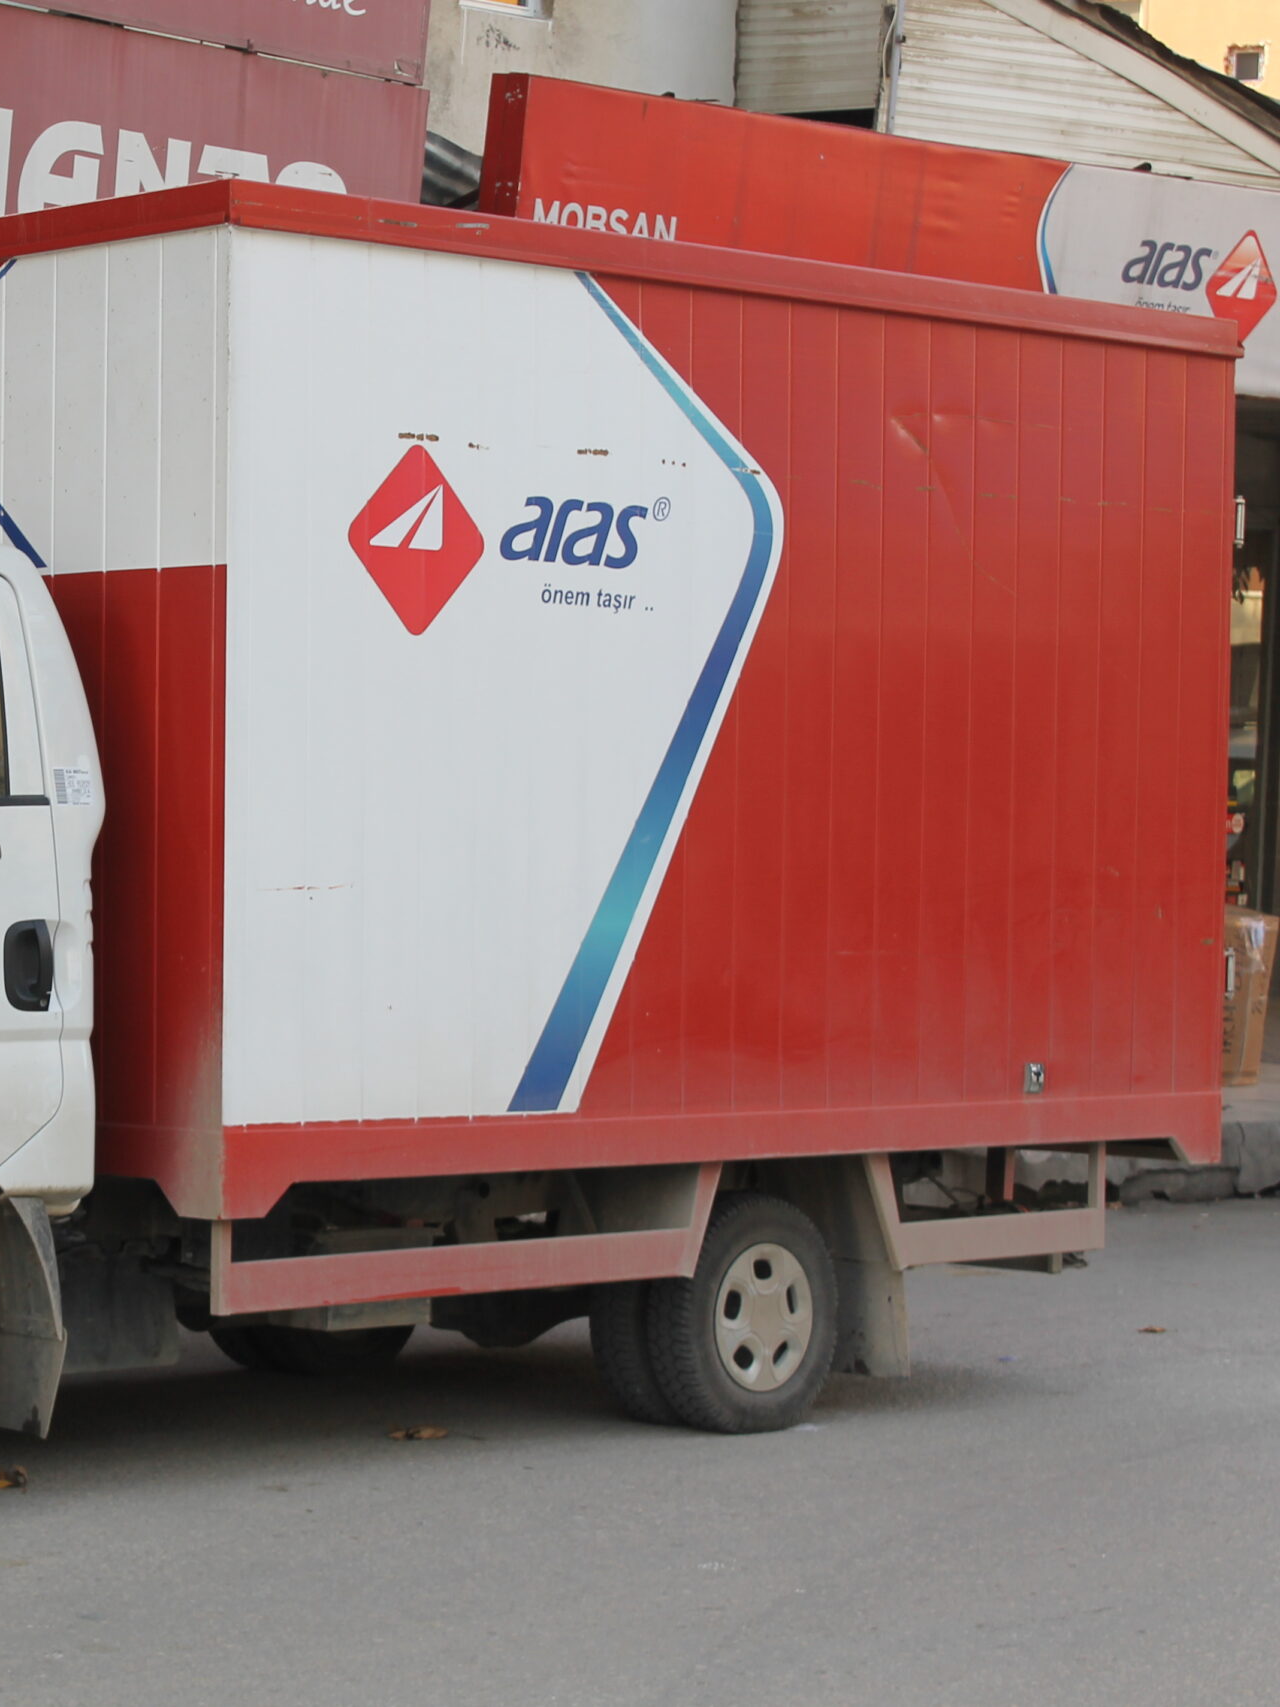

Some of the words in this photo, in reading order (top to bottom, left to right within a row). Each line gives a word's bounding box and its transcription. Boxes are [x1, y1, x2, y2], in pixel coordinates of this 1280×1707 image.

[1121, 240, 1213, 291] aras
[499, 496, 648, 570] aras
[541, 583, 590, 607] önem
[597, 588, 636, 614] taşır
